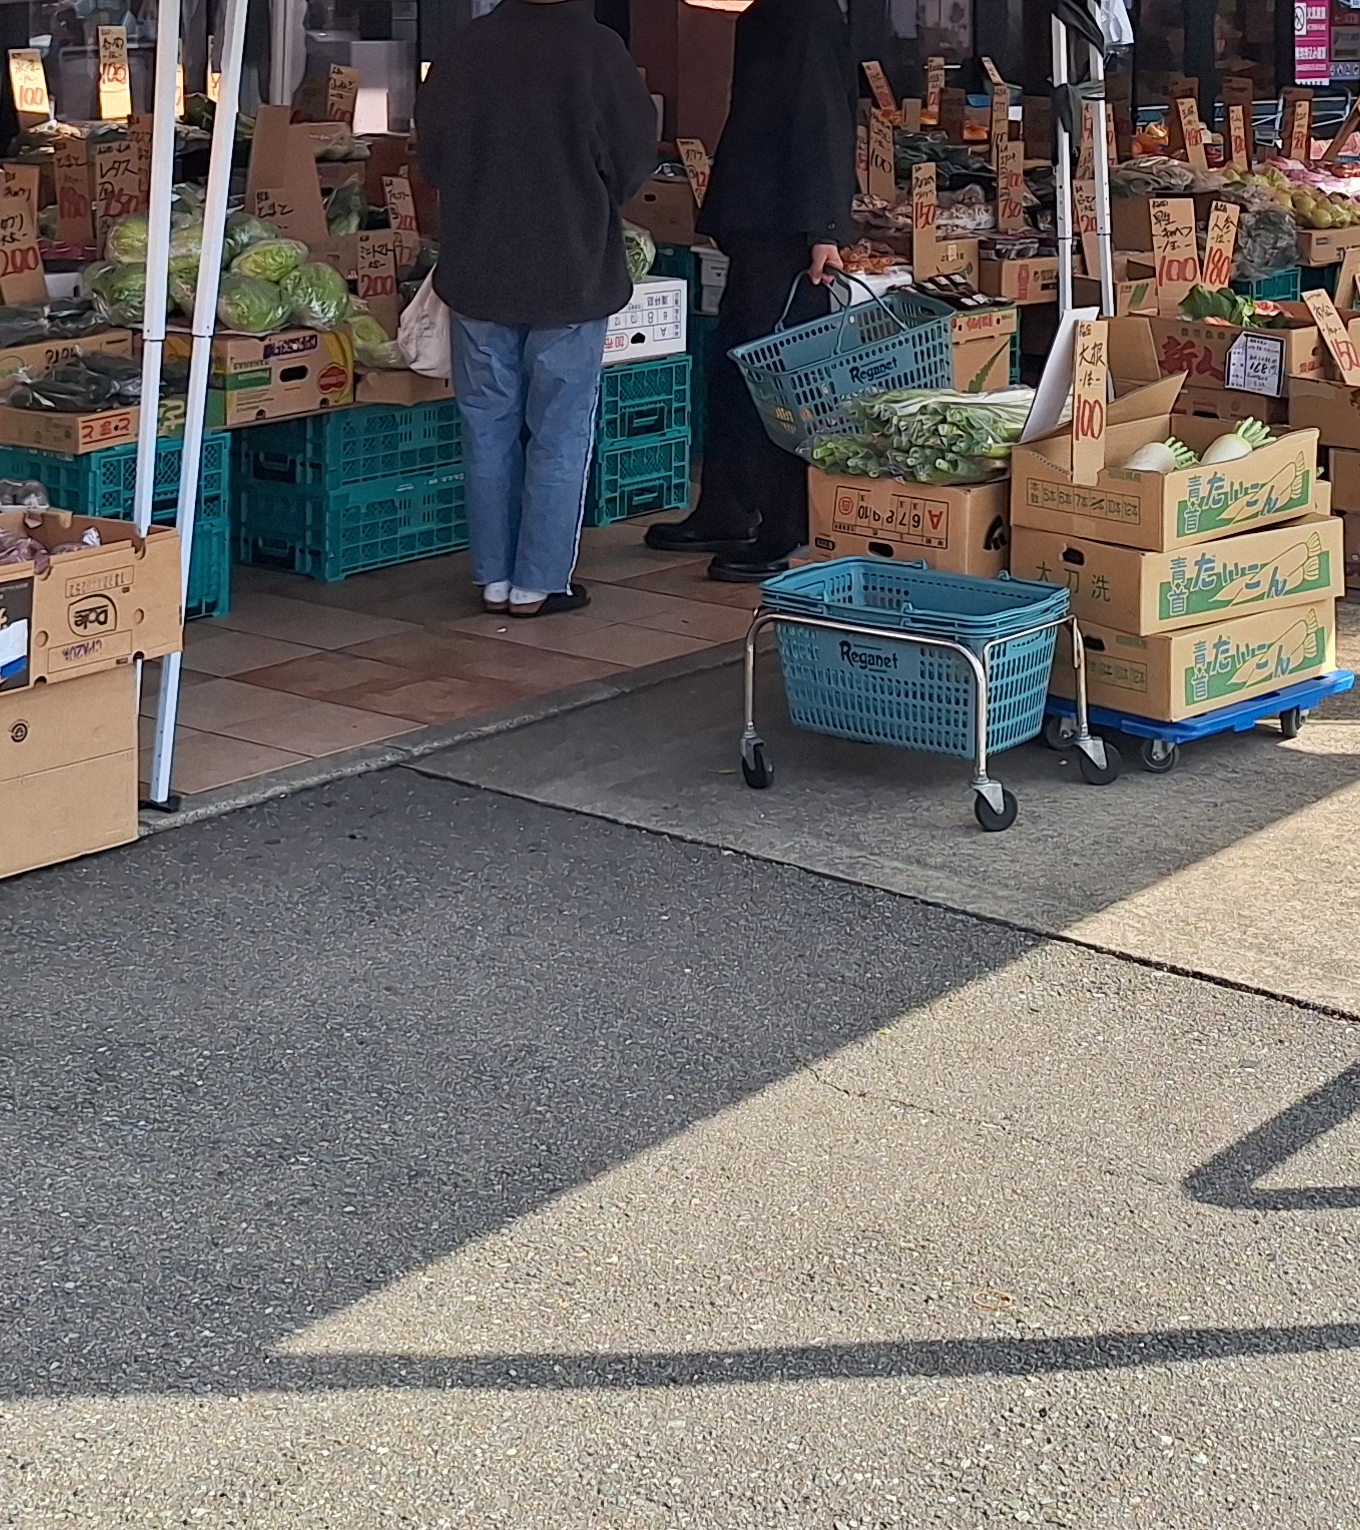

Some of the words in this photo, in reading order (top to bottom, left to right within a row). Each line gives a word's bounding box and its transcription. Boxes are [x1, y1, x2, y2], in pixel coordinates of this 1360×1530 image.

[19, 84, 45, 108] 100
[99, 158, 139, 179] レタス
[1158, 255, 1199, 287] 100
[1203, 246, 1231, 286] 180
[361, 274, 396, 299] 200
[660, 327, 667, 337] A
[1079, 342, 1106, 367] 大根
[850, 356, 898, 384] Reganet
[1075, 394, 1104, 441] 100
[858, 504, 870, 520] 10
[1184, 474, 1203, 534] 青首
[1202, 470, 1279, 516] だいこん
[899, 511, 907, 527] 7
[912, 513, 922, 529] 6
[927, 509, 944, 531] A
[1167, 555, 1189, 617] 青首
[1192, 551, 1288, 599] だいこん
[74, 608, 109, 630] Dole
[839, 640, 899, 670] Reganet
[1190, 639, 1210, 701] 青首
[1210, 634, 1291, 678] だいこん
